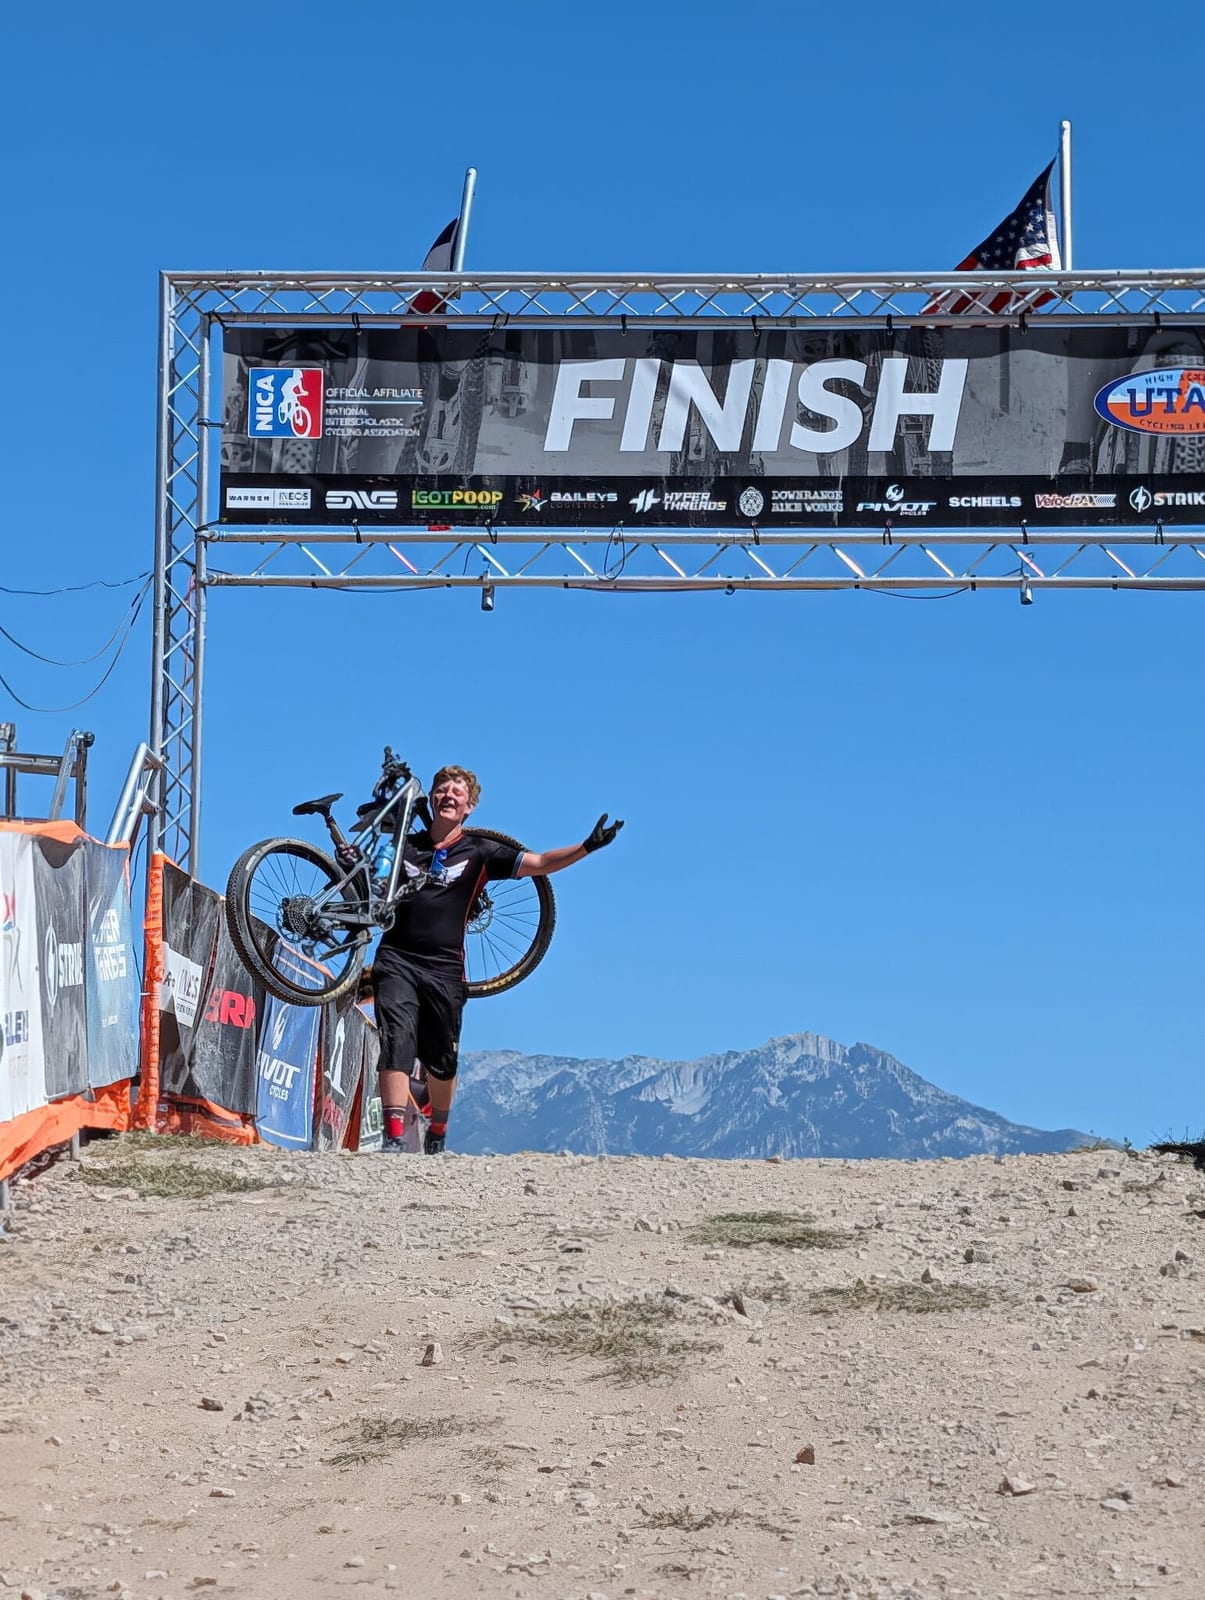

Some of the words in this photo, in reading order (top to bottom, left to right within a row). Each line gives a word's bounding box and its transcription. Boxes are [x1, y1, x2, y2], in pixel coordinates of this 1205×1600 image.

[1144, 374, 1174, 385] HIGH
[325, 388, 370, 398] OFFICIAL
[372, 388, 424, 399] AFFILIATE
[255, 374, 275, 431] NICA
[544, 358, 969, 453] FINISH
[325, 408, 369, 416] NATIONAL
[325, 428, 362, 437] CYCLING
[364, 428, 421, 437] ASSOCIATION
[279, 492, 309, 501] INEOS
[550, 492, 618, 502] BAILEYS
[663, 492, 711, 501] HYPER
[771, 490, 843, 500] DOWNRANGE
[550, 502, 606, 510] LOGISTICS
[663, 501, 728, 511] THREADS
[949, 496, 1022, 507] SCHEELS
[771, 502, 803, 512] BIKE
[805, 502, 844, 512] WORKS
[856, 502, 937, 512] PIVOT
[269, 1084, 289, 1102] CYCLES
